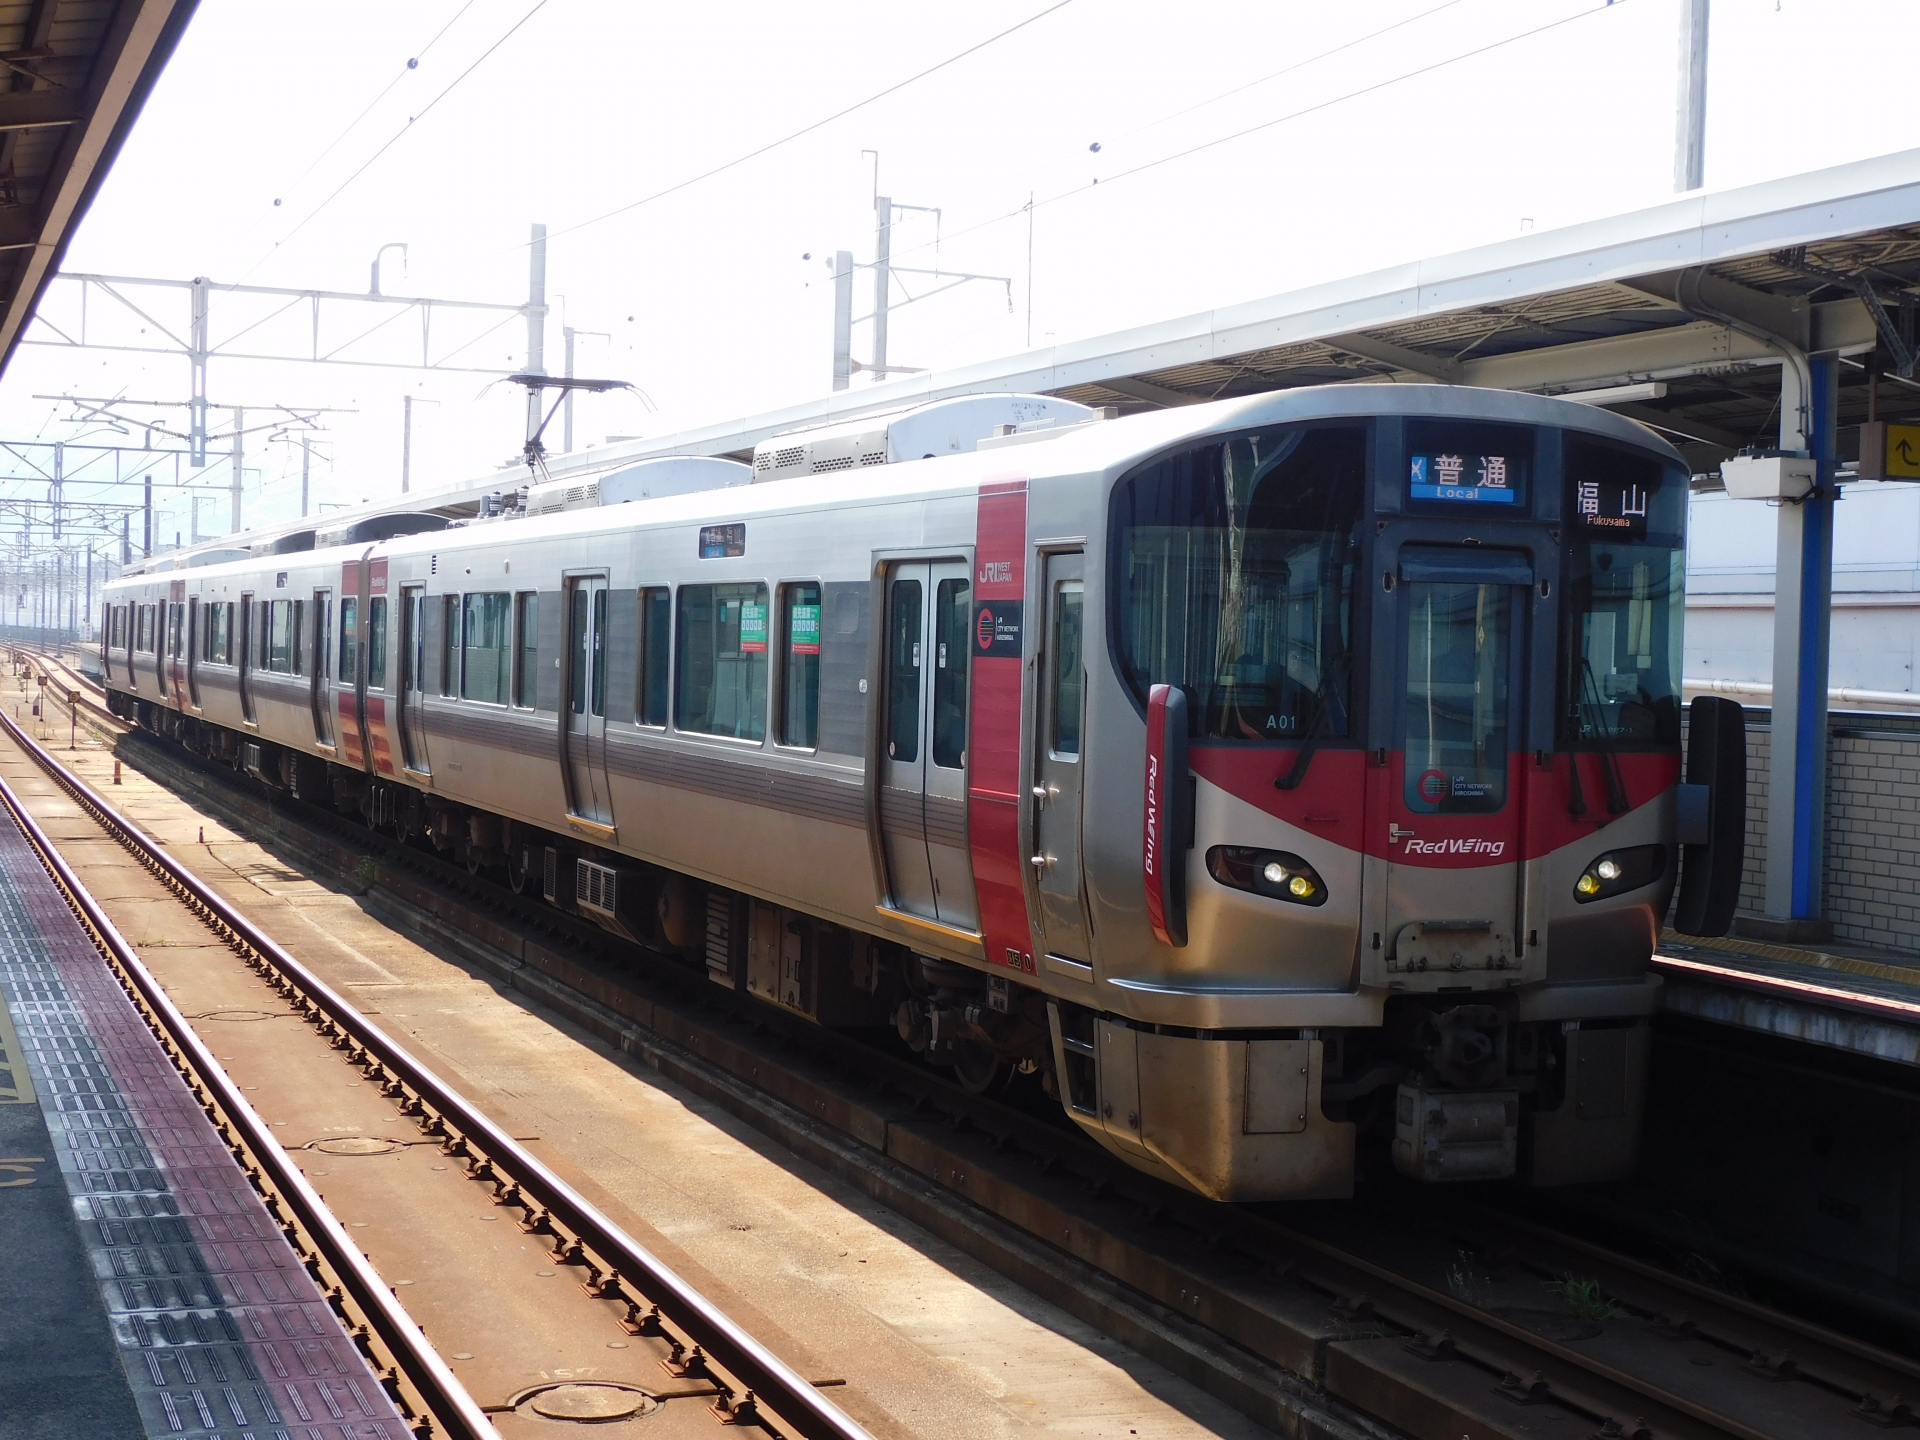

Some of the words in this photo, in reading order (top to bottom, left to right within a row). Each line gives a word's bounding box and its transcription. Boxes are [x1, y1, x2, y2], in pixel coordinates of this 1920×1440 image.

[1433, 453, 1507, 488] 普通
[1436, 486, 1479, 499] Local
[1577, 480, 1647, 517] 福山
[1586, 514, 1631, 527] Fukuyama
[979, 562, 994, 583] JR
[997, 561, 1011, 572] WEST
[996, 572, 1013, 583] JAPAN
[1266, 714, 1296, 729] A01
[1580, 724, 1591, 733] JR
[1145, 754, 1158, 876] RedWing
[1404, 838, 1505, 857] RedWing
